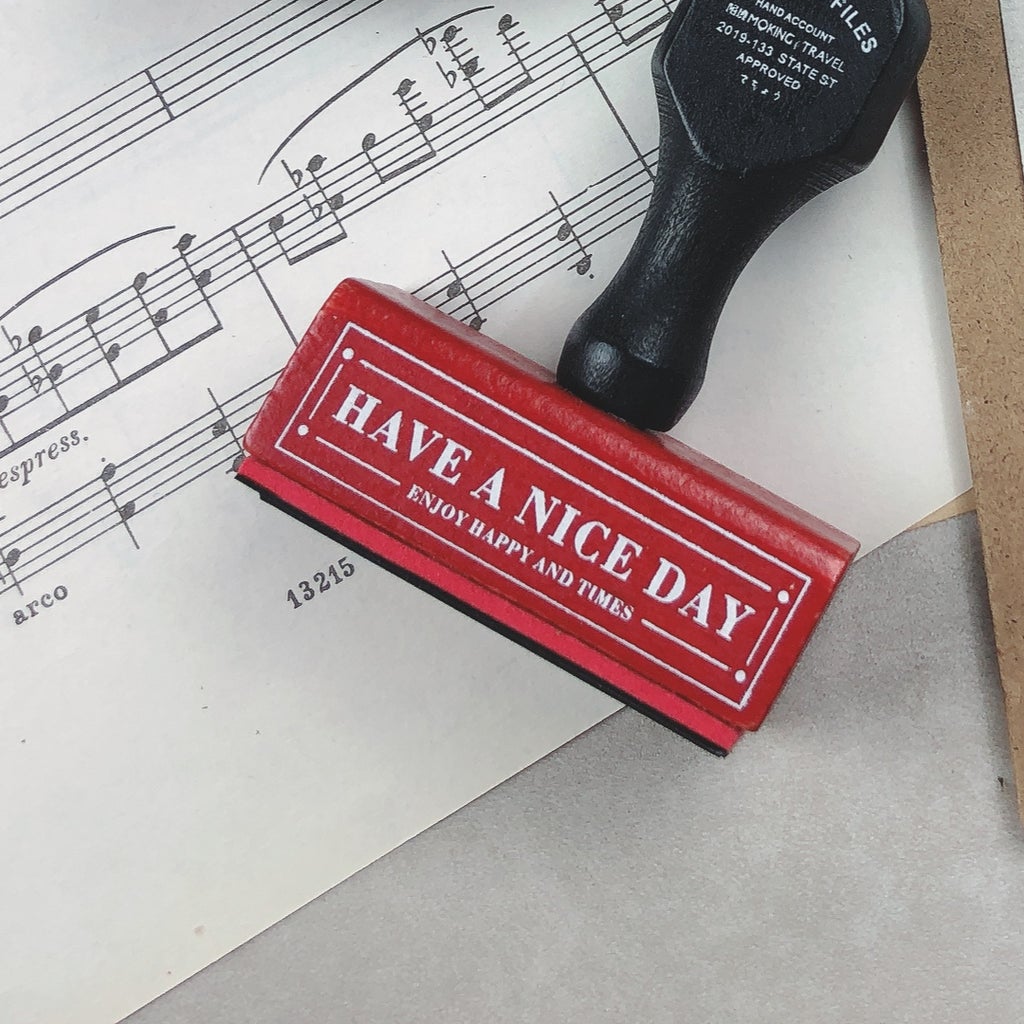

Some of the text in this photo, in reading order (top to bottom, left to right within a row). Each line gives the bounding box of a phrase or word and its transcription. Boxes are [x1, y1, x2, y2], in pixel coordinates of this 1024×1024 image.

[784, 13, 836, 44] ACCOUNT
[716, 21, 838, 89] 2019-133 STATE ST
[736, 53, 800, 90] APPROVED
[802, 41, 845, 73] TRAVEL
[332, 384, 756, 642] HAVE A NICE DAY
[406, 484, 635, 622] ENJOY HAPPY AND TIMES
[12, 585, 68, 626] arco
[287, 556, 355, 609] 13215
